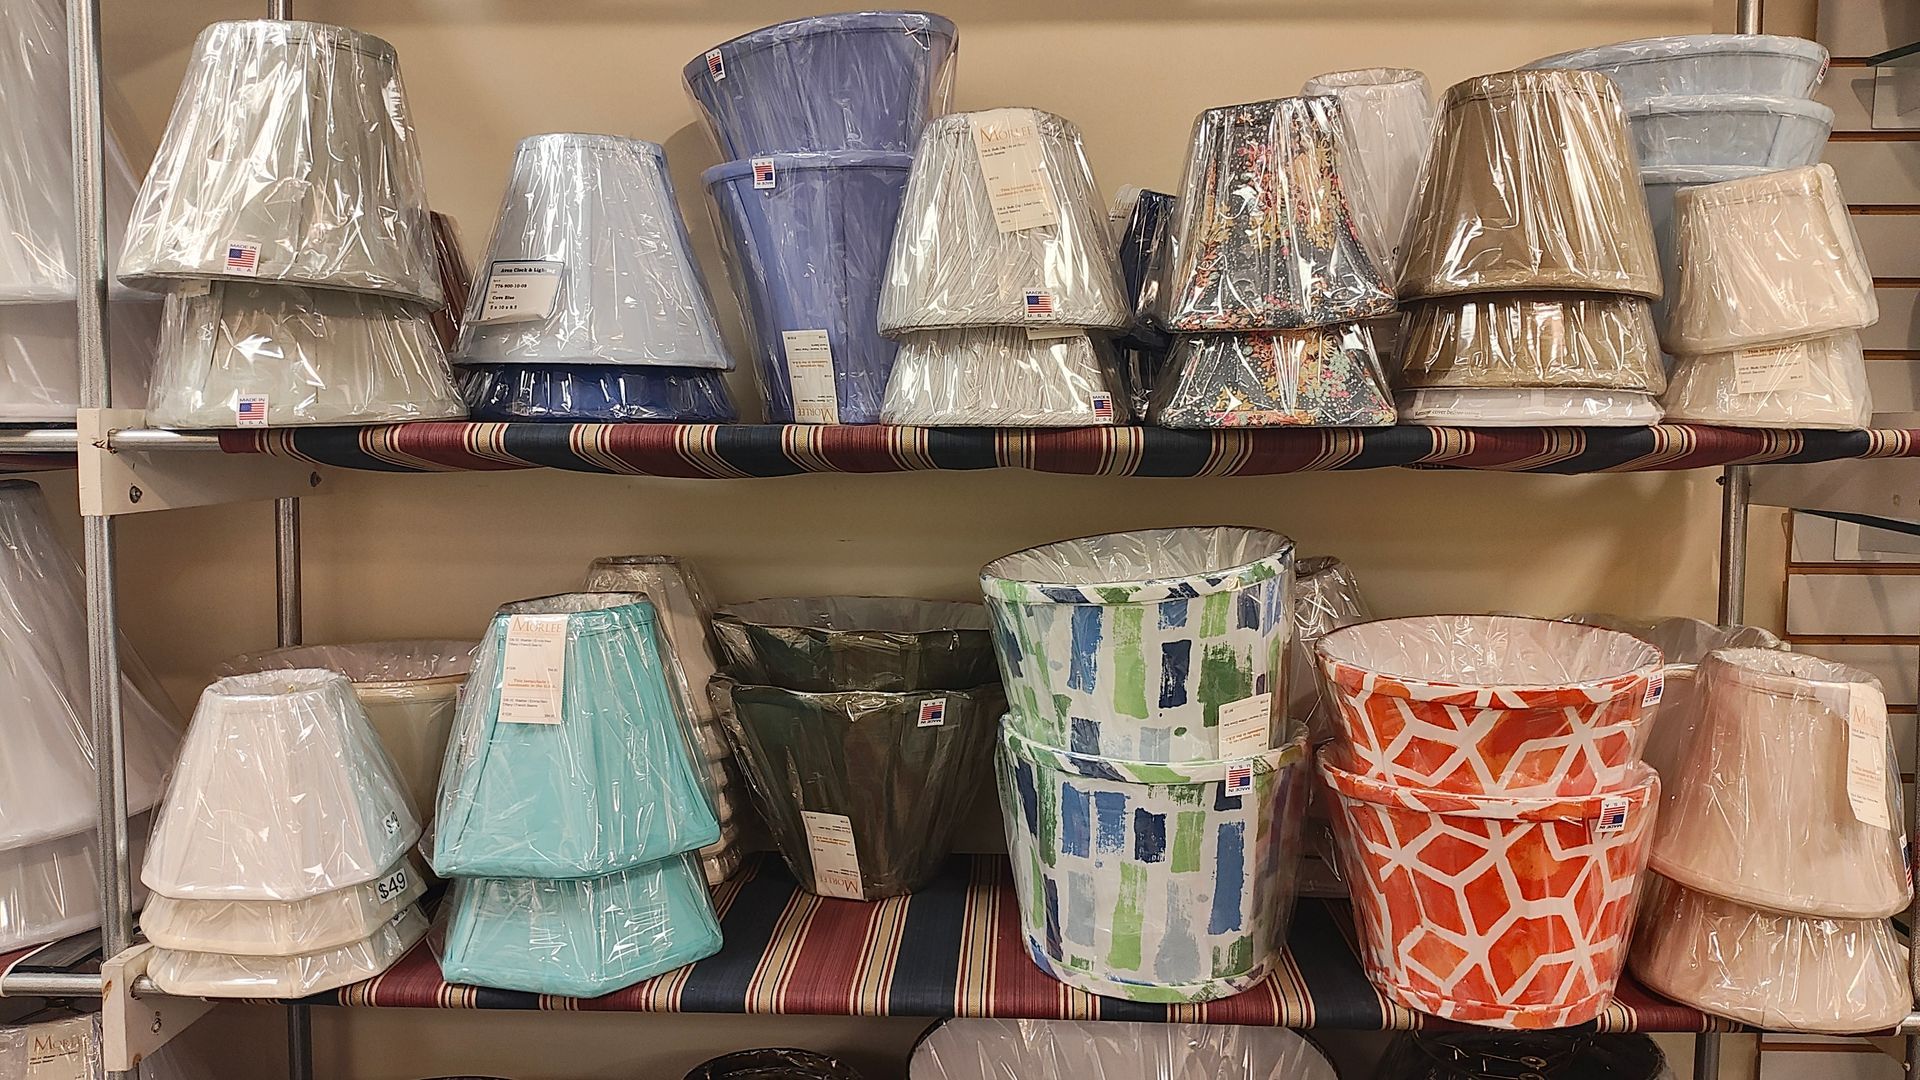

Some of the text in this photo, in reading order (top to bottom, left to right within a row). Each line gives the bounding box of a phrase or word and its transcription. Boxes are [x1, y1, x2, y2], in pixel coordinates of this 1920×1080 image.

[797, 406, 835, 423] MORLEE
[512, 616, 562, 634] MORLEE
[378, 872, 406, 899] $49
